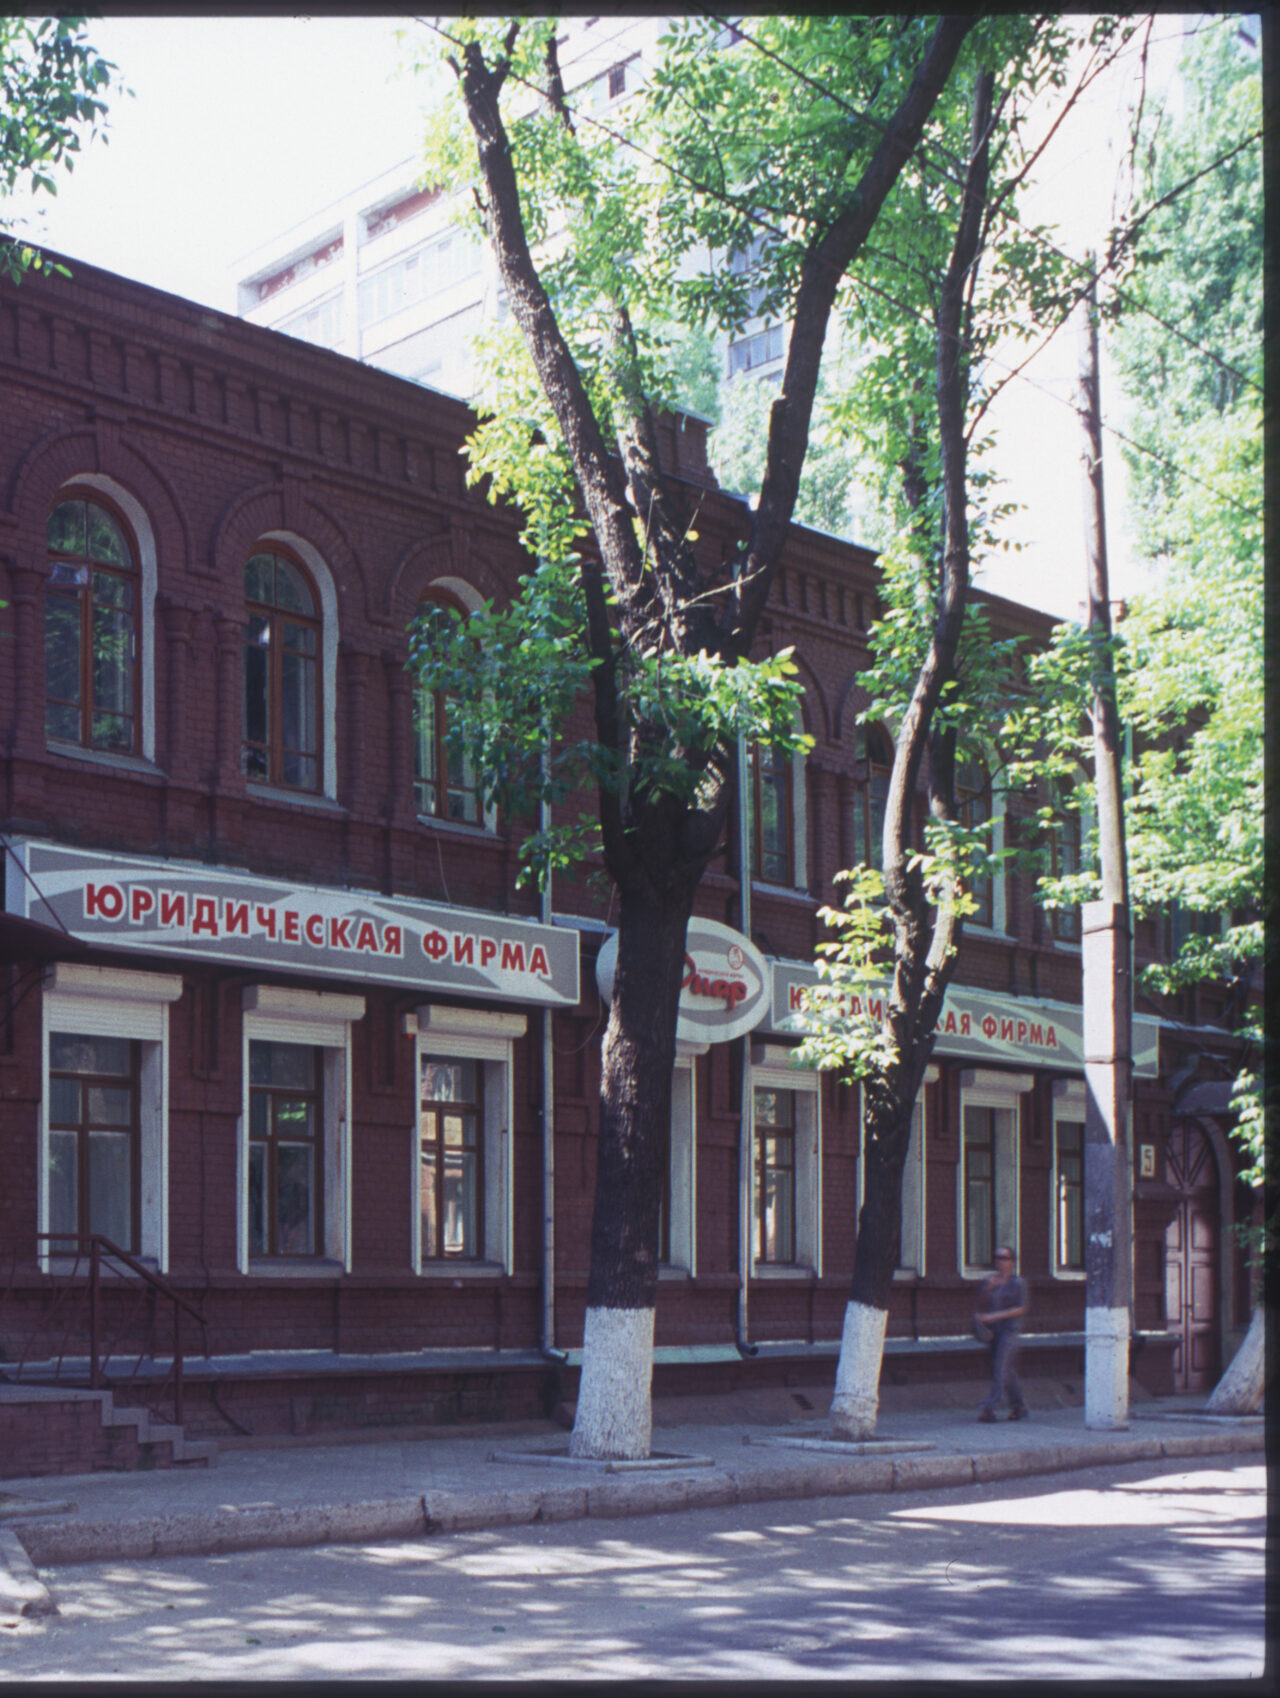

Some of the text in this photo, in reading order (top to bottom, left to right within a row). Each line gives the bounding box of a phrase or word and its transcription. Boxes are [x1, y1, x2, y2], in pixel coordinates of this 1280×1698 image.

[86, 883, 549, 975] ЮРИДИЧЕСКАЯ ФИРМА
[982, 1015, 1057, 1047] ФИРМА
